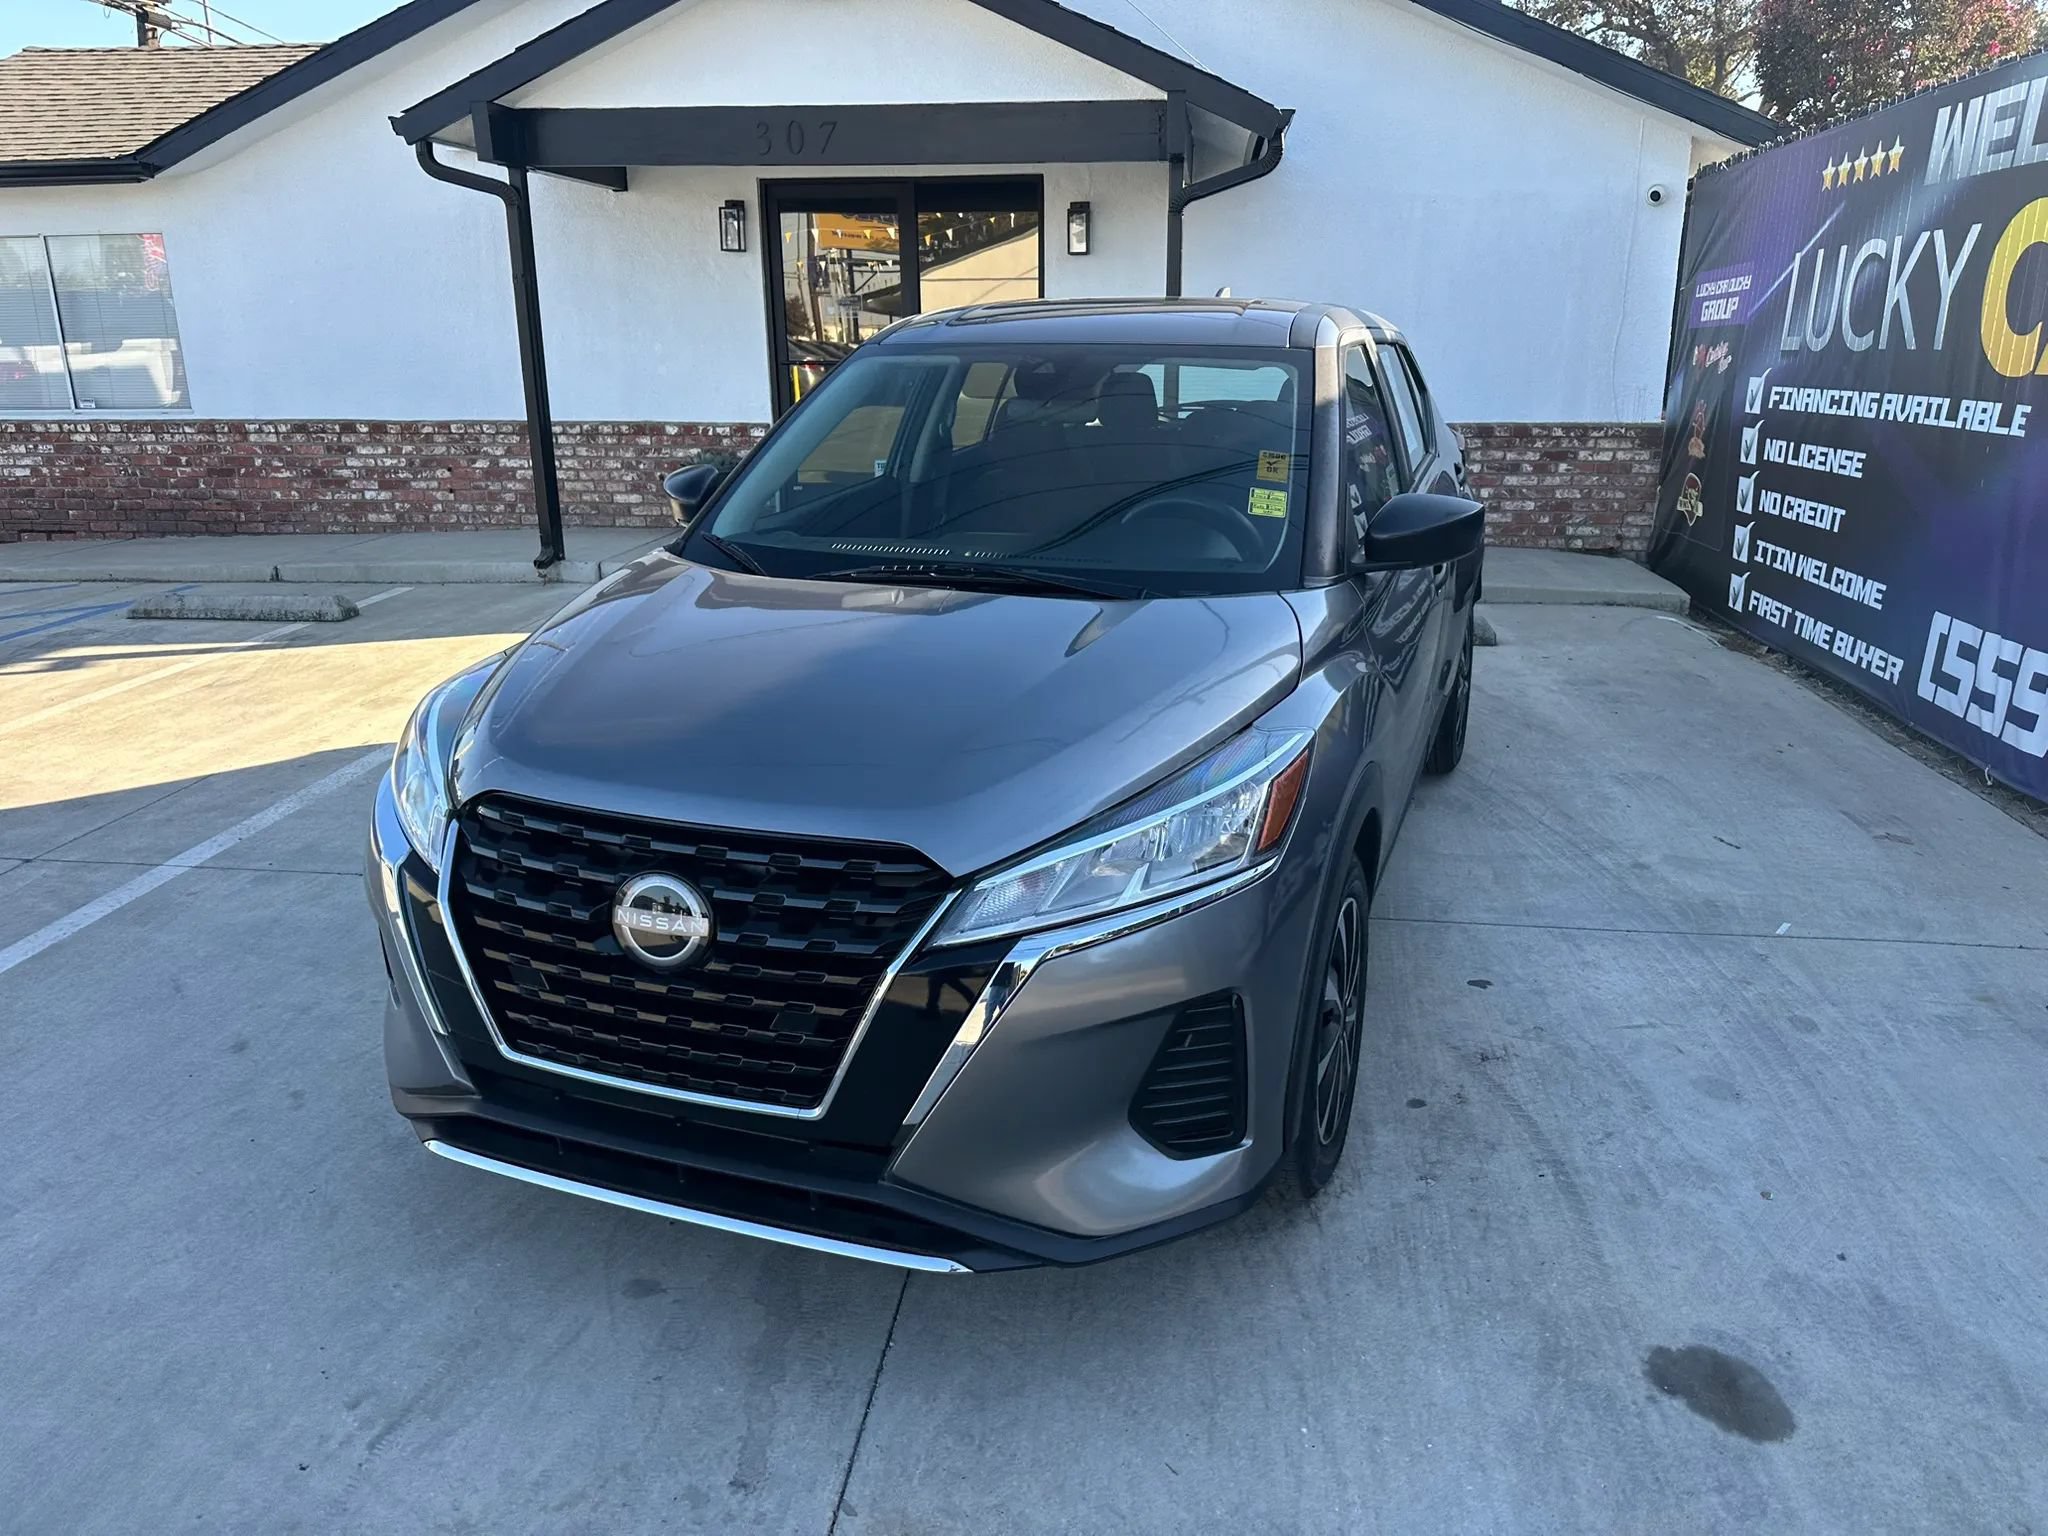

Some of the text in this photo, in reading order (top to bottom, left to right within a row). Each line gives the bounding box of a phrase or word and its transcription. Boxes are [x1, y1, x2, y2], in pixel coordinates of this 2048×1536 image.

[757, 120, 837, 155] 307
[1700, 296, 1740, 322] GROUP
[1781, 223, 1983, 352] LUCKY
[1768, 386, 2032, 438] FINANCING AVAILABLE
[1763, 438, 1867, 478] NO LICENSE
[1758, 489, 1847, 533] NO CREDIT
[1753, 539, 1888, 610] ITIN WELCOME
[1748, 590, 1905, 686] FIRST TIME BUYER
[617, 909, 705, 933] NISSAN
